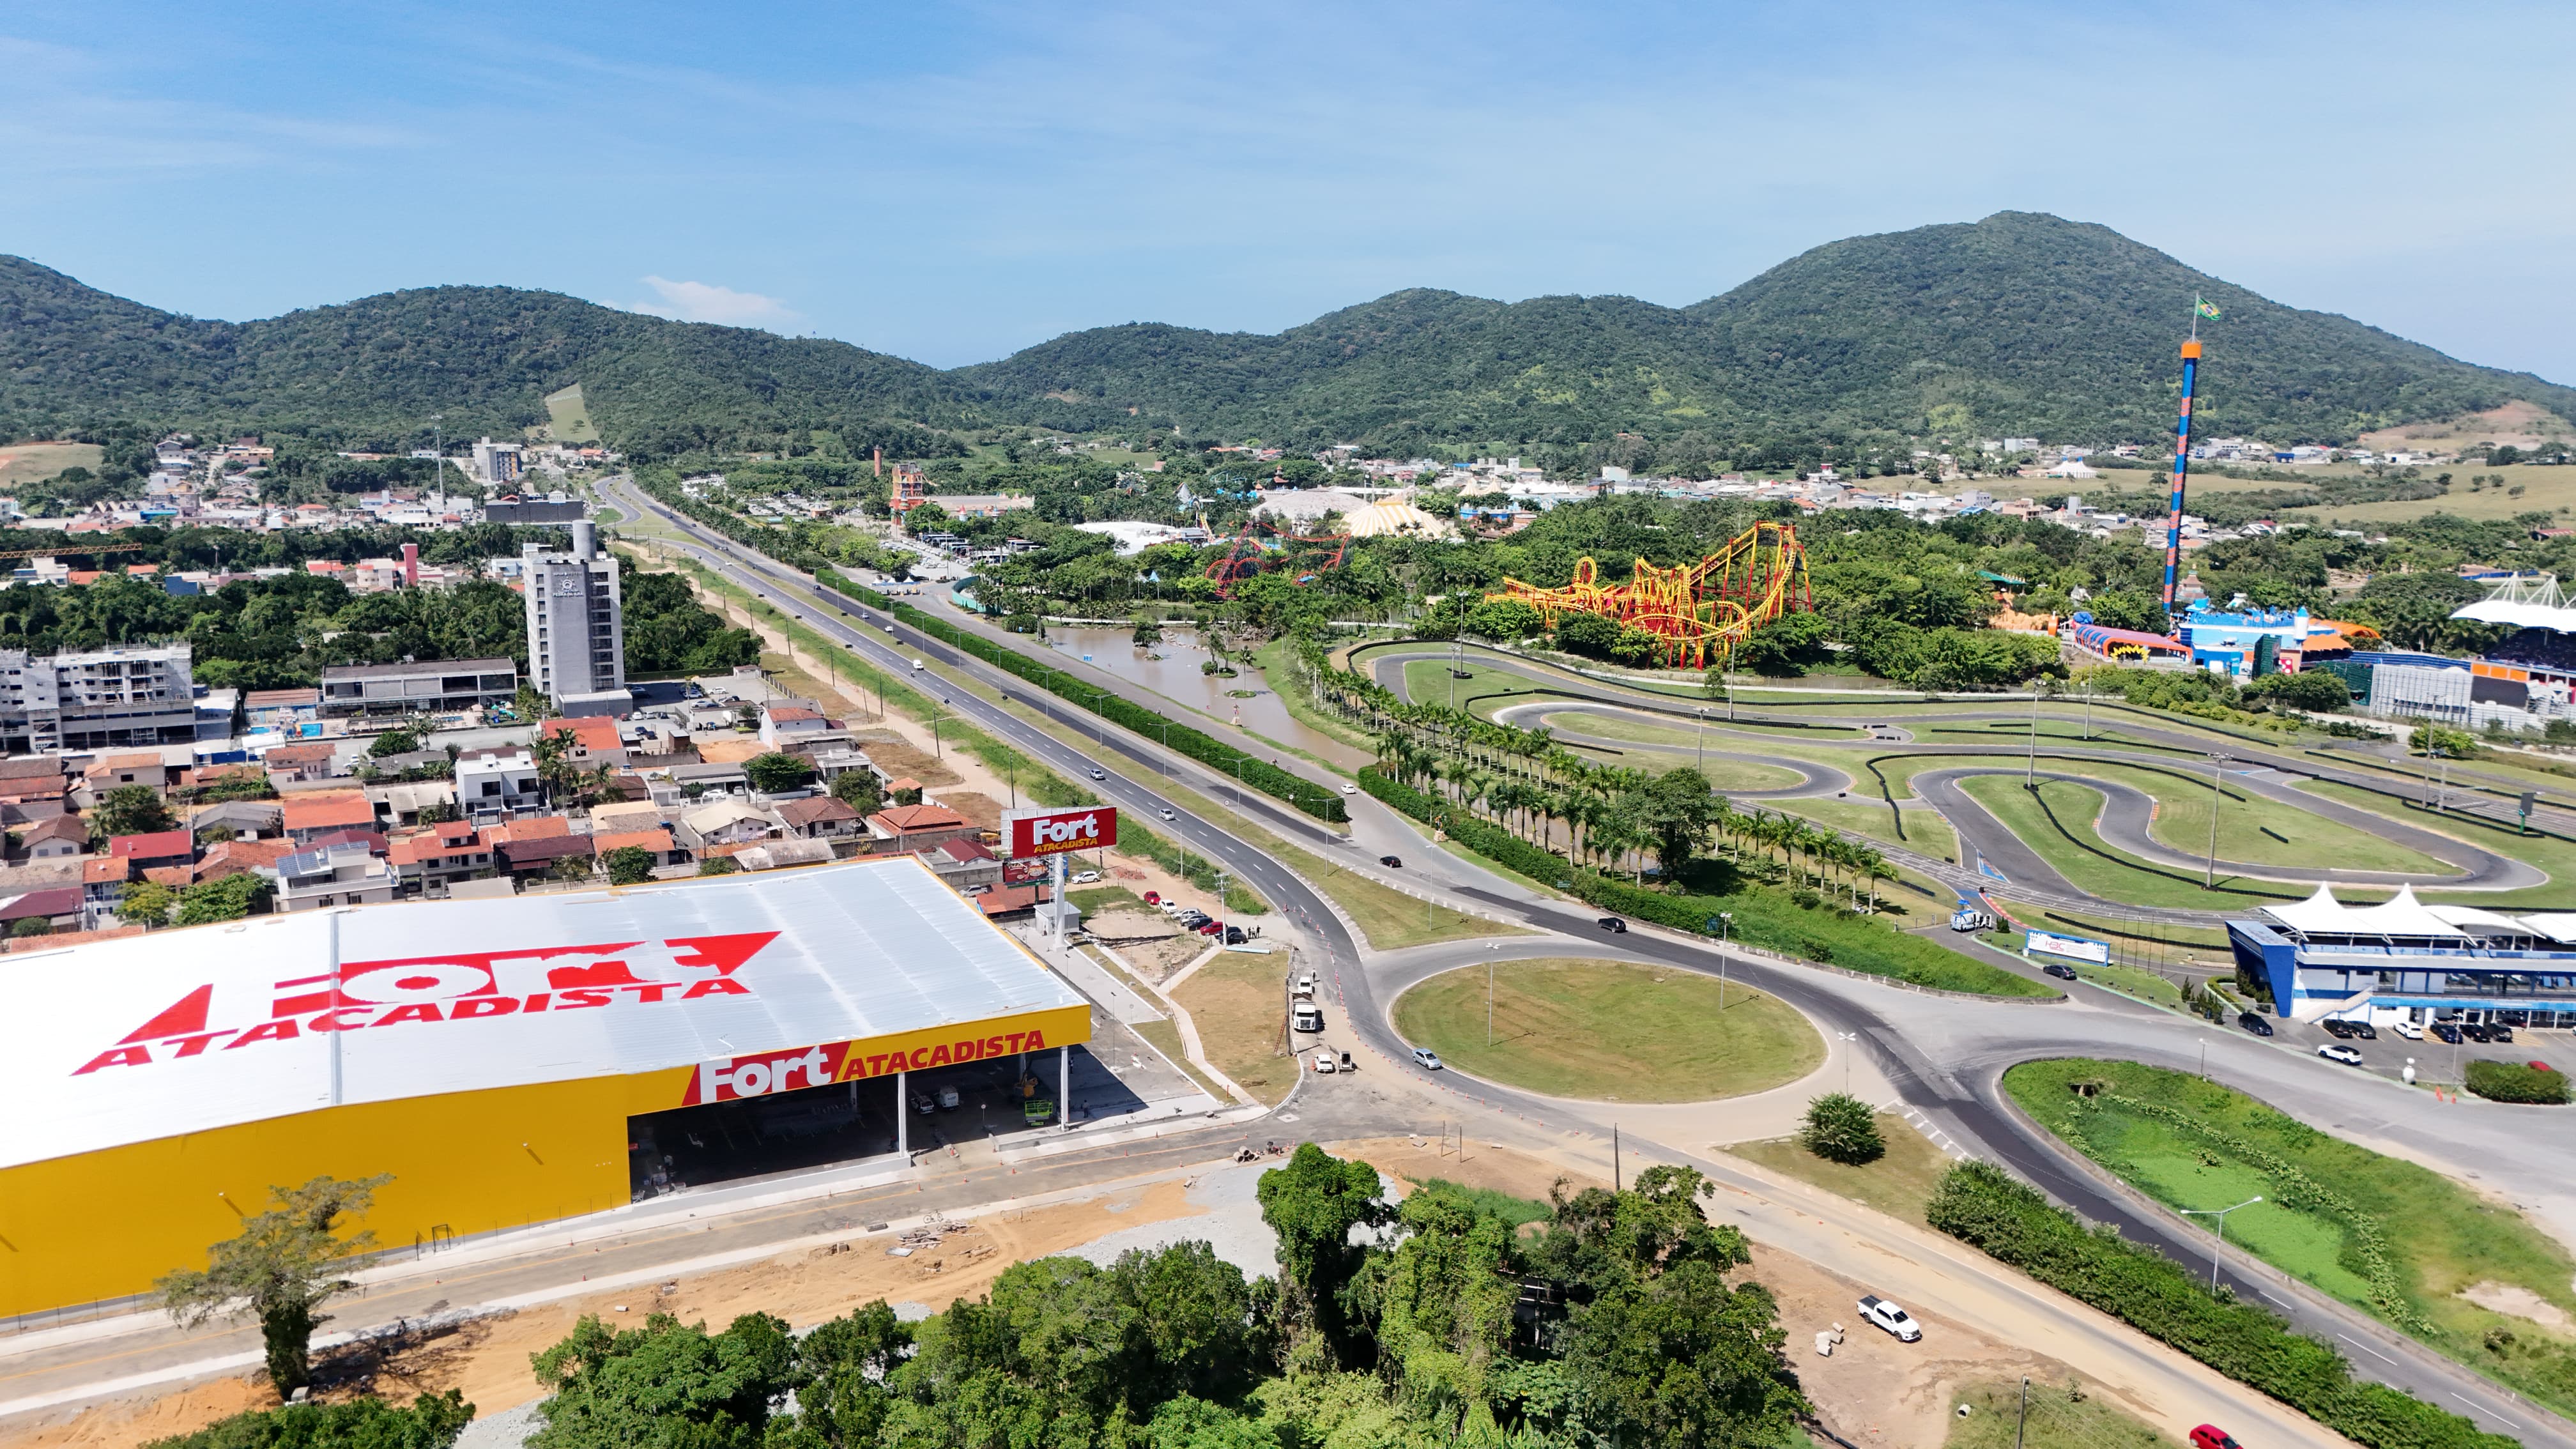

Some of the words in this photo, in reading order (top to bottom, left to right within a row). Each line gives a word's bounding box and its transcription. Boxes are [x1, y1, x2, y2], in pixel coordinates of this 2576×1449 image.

[1033, 813, 1099, 845] Fort
[1034, 837, 1098, 854] ATACADISTA
[194, 935, 722, 1031] Fort
[69, 978, 751, 1077] ATACADISTA
[700, 1045, 832, 1104] Fort
[843, 1030, 1045, 1081] ATACADISTA
